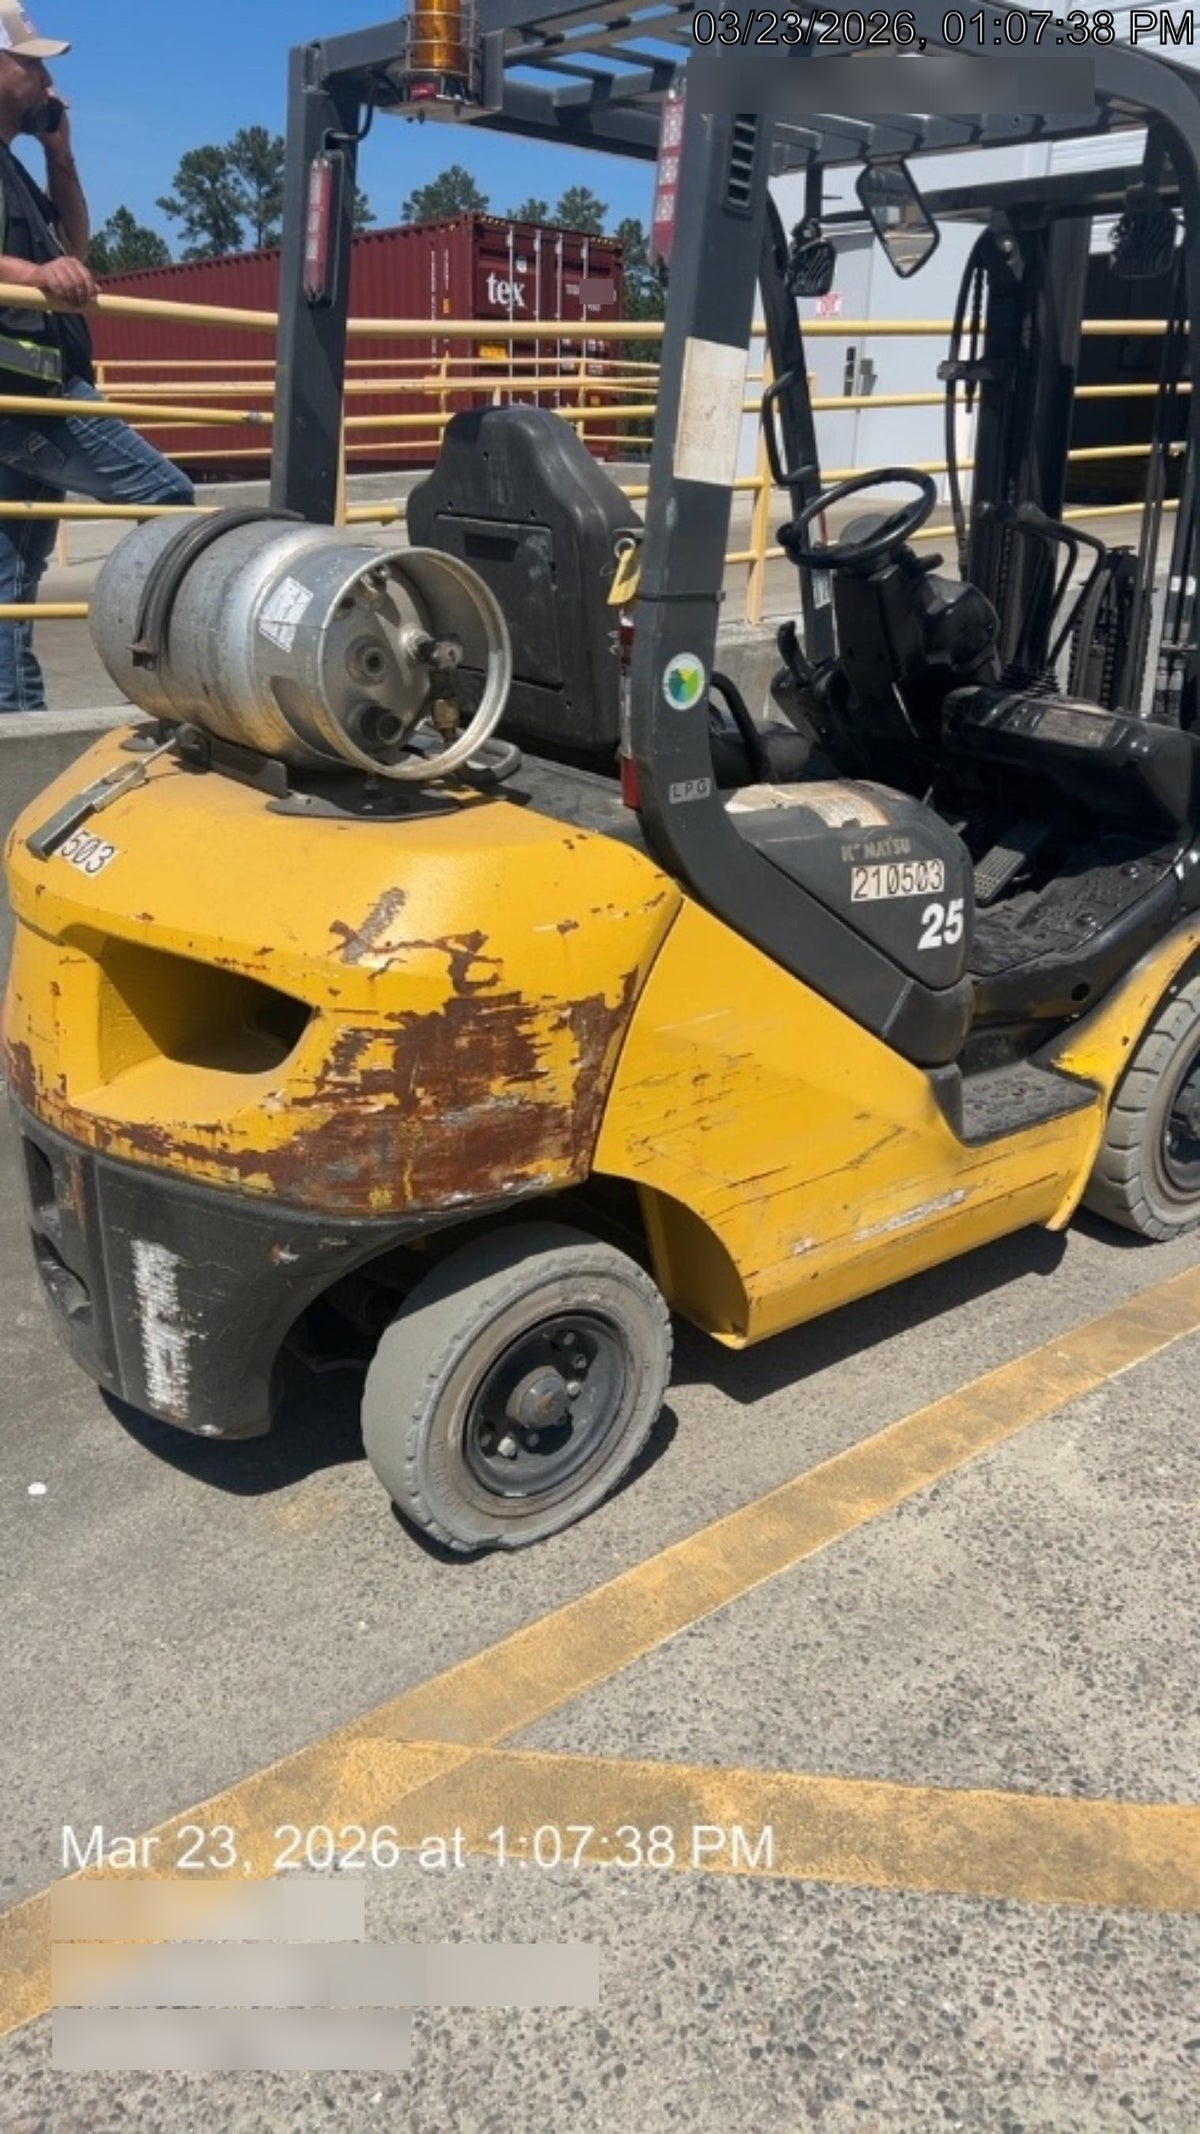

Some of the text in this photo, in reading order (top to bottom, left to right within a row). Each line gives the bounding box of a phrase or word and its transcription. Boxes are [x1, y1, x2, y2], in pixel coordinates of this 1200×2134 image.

[486, 271, 527, 308] tex
[672, 778, 708, 798] LPG
[853, 860, 943, 898] 210503
[917, 898, 964, 950] 25
